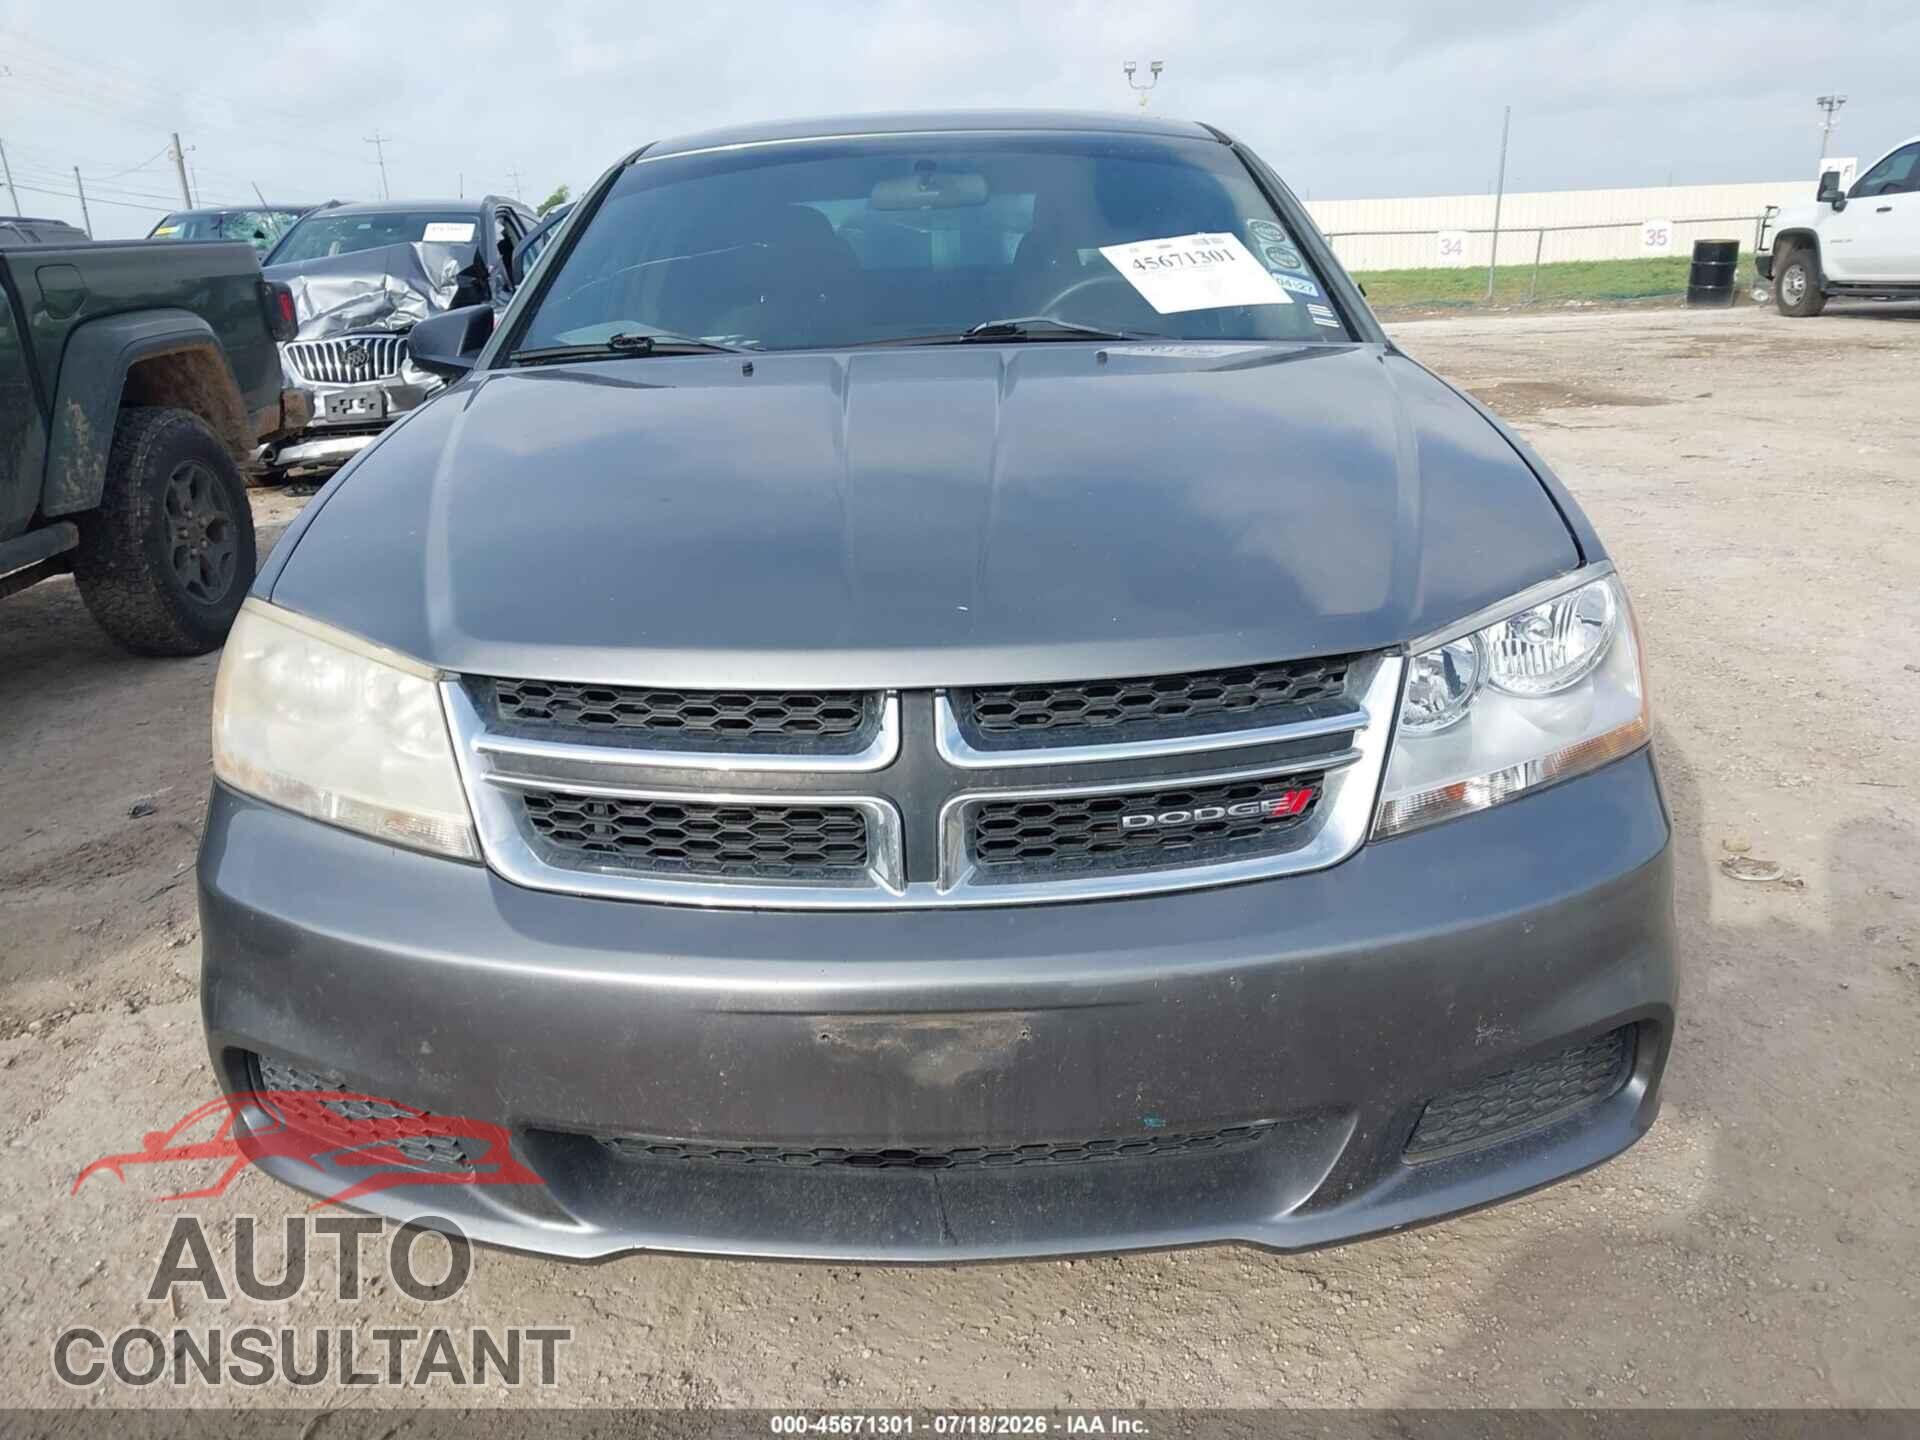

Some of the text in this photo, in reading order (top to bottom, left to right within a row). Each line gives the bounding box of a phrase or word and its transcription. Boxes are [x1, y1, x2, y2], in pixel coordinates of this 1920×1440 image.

[1440, 238, 1464, 256] 34
[1645, 228, 1669, 247] 35
[1132, 248, 1236, 271] 45671301
[1121, 796, 1290, 829] DODGE
